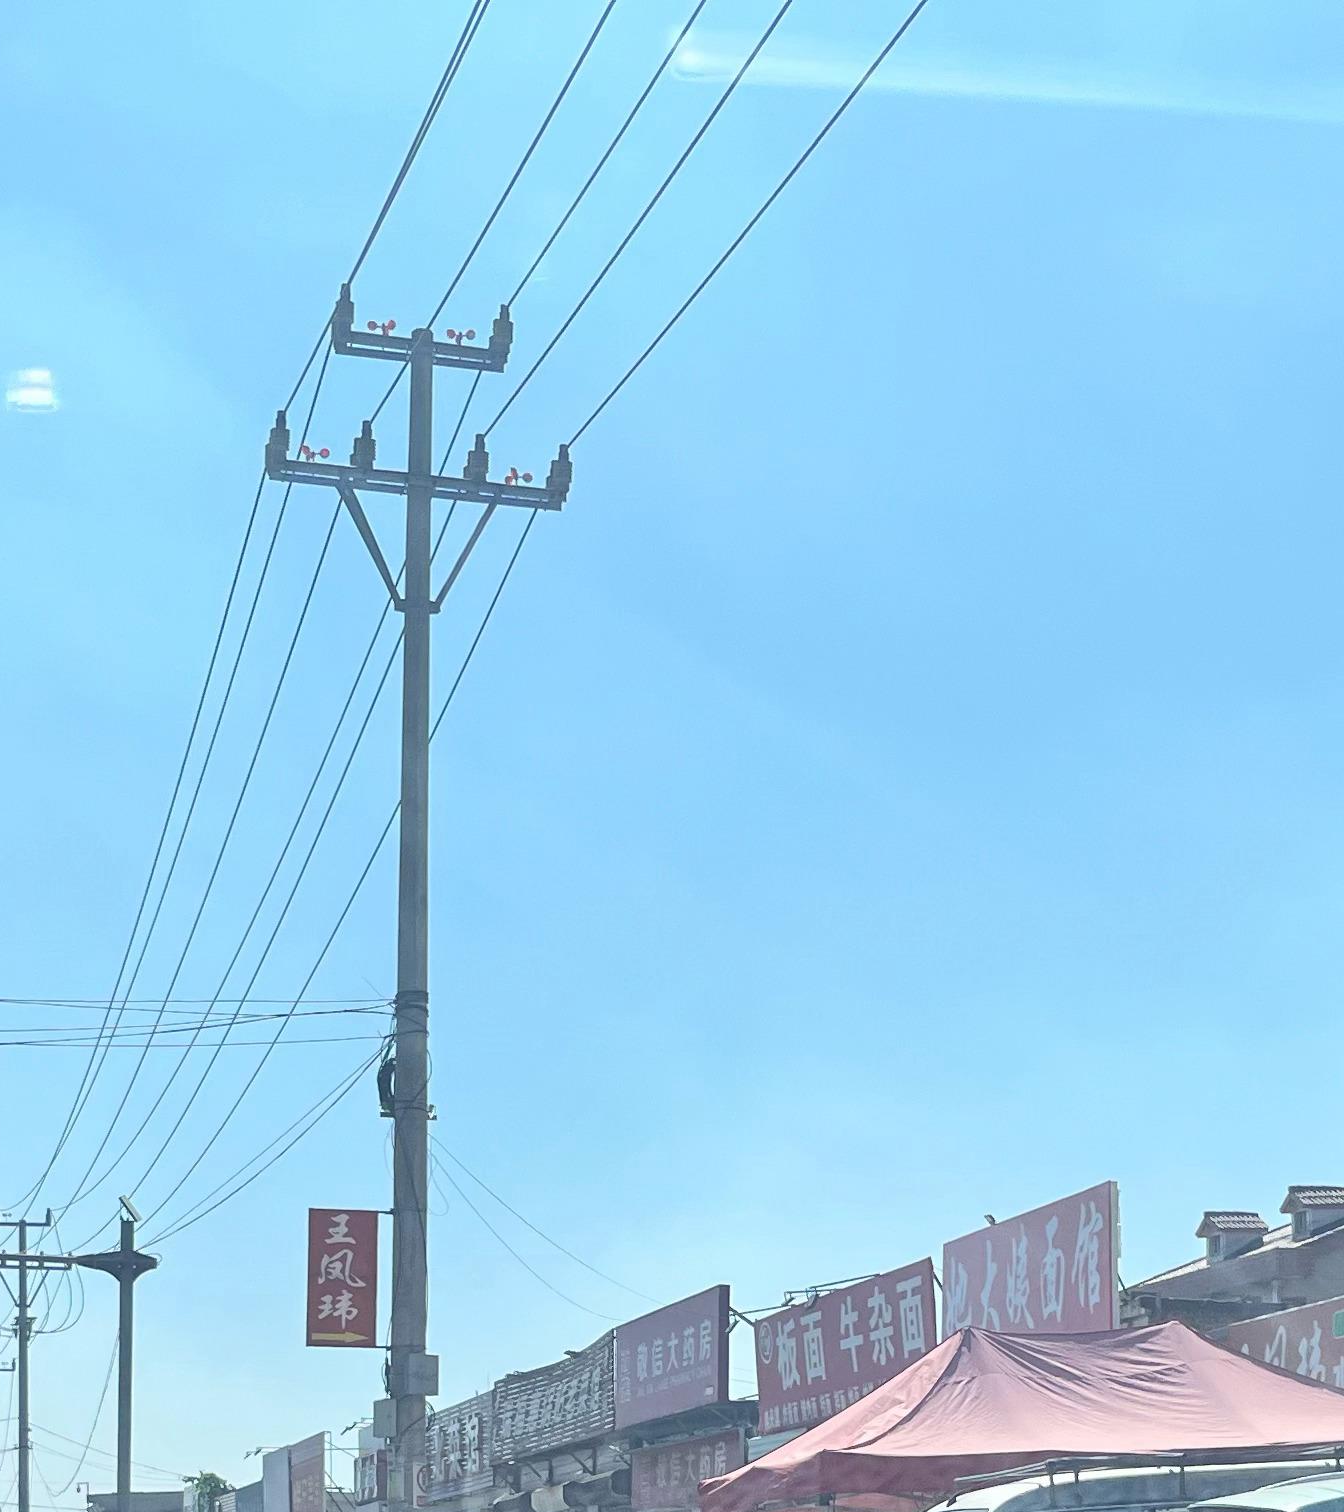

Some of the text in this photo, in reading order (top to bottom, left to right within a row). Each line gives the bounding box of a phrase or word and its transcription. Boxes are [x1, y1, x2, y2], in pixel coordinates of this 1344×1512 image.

[318, 1213, 367, 1330] 王凤玮
[775, 1310, 827, 1392] 板面
[839, 1275, 926, 1373] 牛杂面
